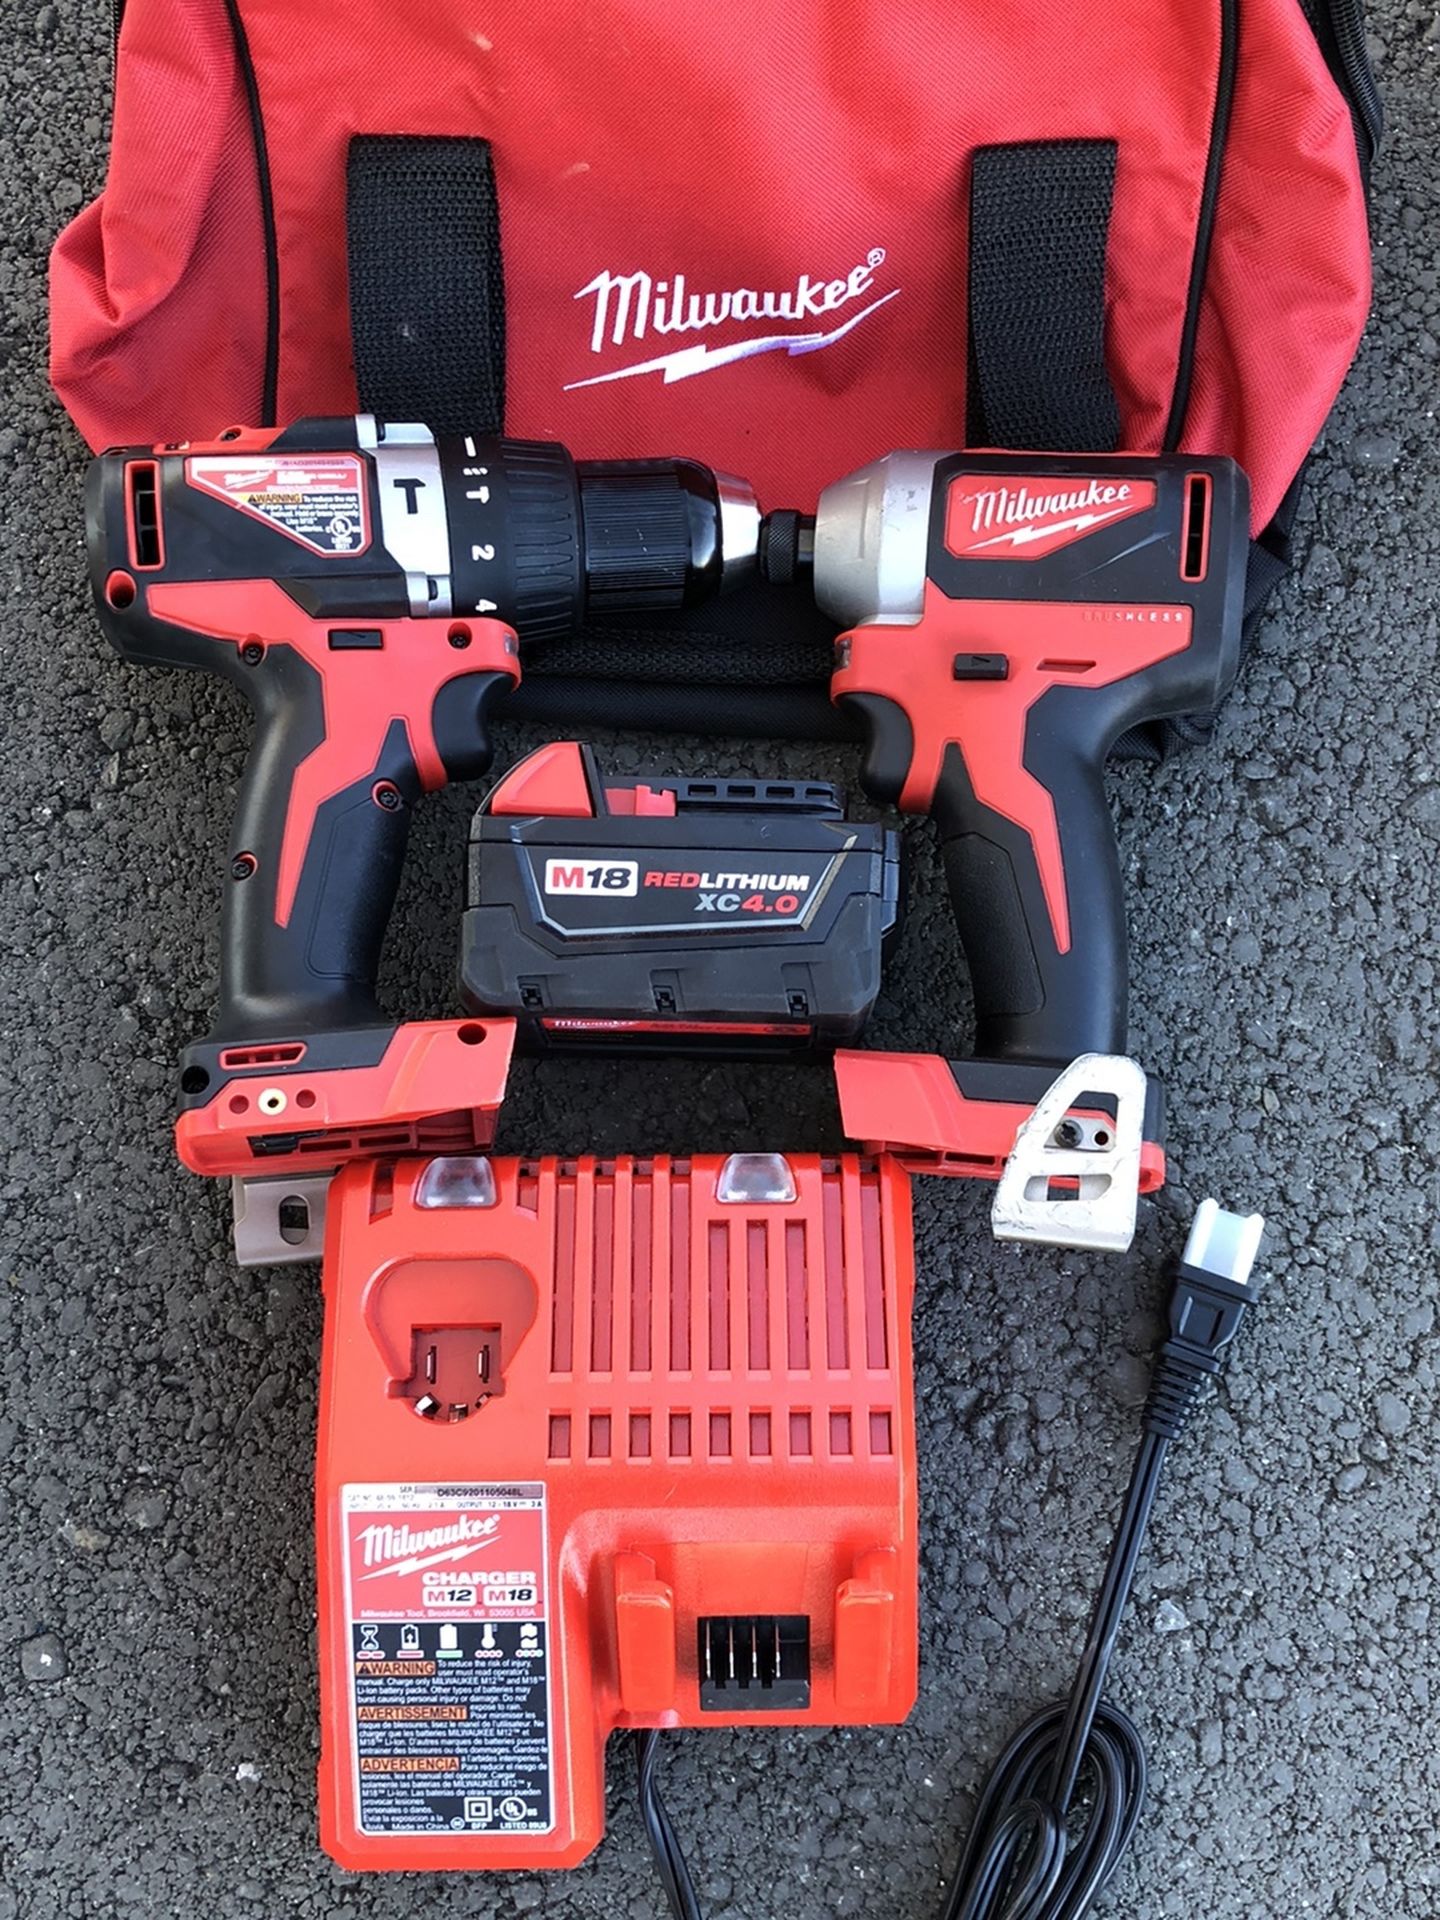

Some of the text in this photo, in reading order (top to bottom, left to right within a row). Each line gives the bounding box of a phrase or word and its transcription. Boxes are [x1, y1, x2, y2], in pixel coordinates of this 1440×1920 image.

[257, 494, 300, 502] WARNING
[960, 480, 1132, 532] Milwaukee
[472, 544, 495, 561] 2
[475, 599, 497, 612] 4
[552, 866, 810, 892] M18 REDLITHIUM
[694, 893, 799, 913] XC4.0
[422, 1571, 536, 1585] CHARGER
[428, 1590, 532, 1602] M12 M18
[516, 1609, 536, 1618] USA
[372, 1662, 434, 1674] WARNING
[438, 1660, 446, 1668] To
[448, 1660, 472, 1668] reduce
[474, 1660, 486, 1668] the
[502, 1660, 510, 1668] of
[360, 1707, 464, 1718] AVERTISSEMENT
[363, 1759, 456, 1769] ADVERTENCIA
[500, 1822, 528, 1830] LISTED
